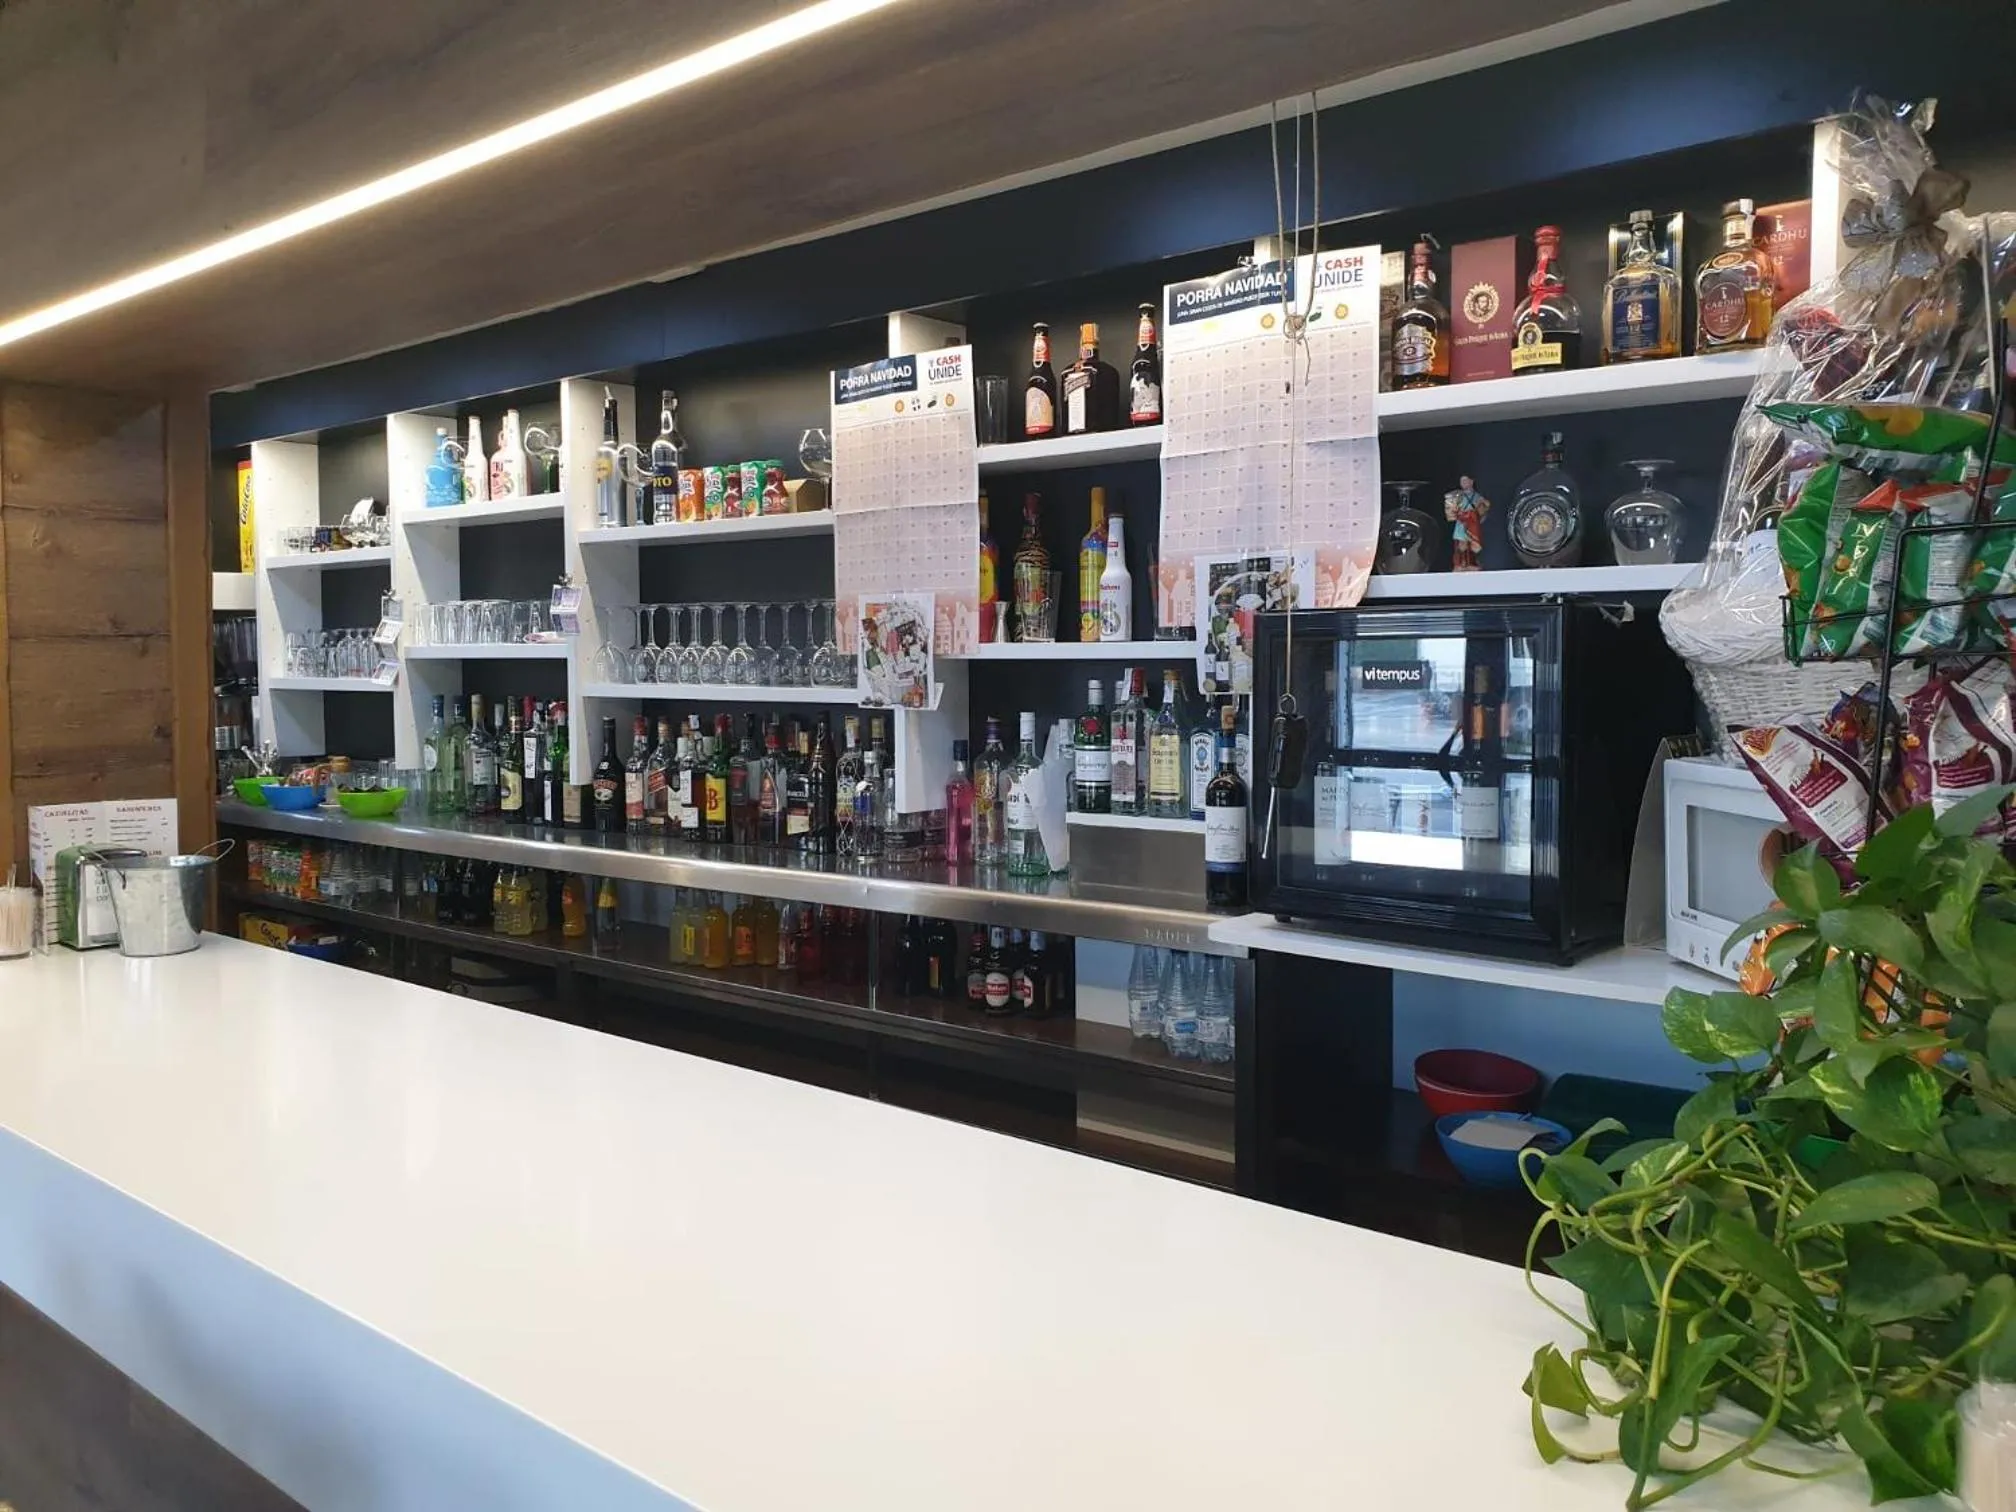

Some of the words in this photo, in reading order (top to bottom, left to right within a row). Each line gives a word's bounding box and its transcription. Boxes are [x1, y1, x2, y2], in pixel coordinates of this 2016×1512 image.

[1325, 255, 1364, 271] CASH
[1176, 285, 1223, 308] PORRA
[1224, 271, 1287, 297] NAVIDAD
[936, 354, 962, 366] CASH
[839, 373, 869, 391] PORRA
[869, 364, 913, 384] NAVIDAD
[928, 363, 963, 381] UNIDE
[1364, 667, 1421, 684] vitempus
